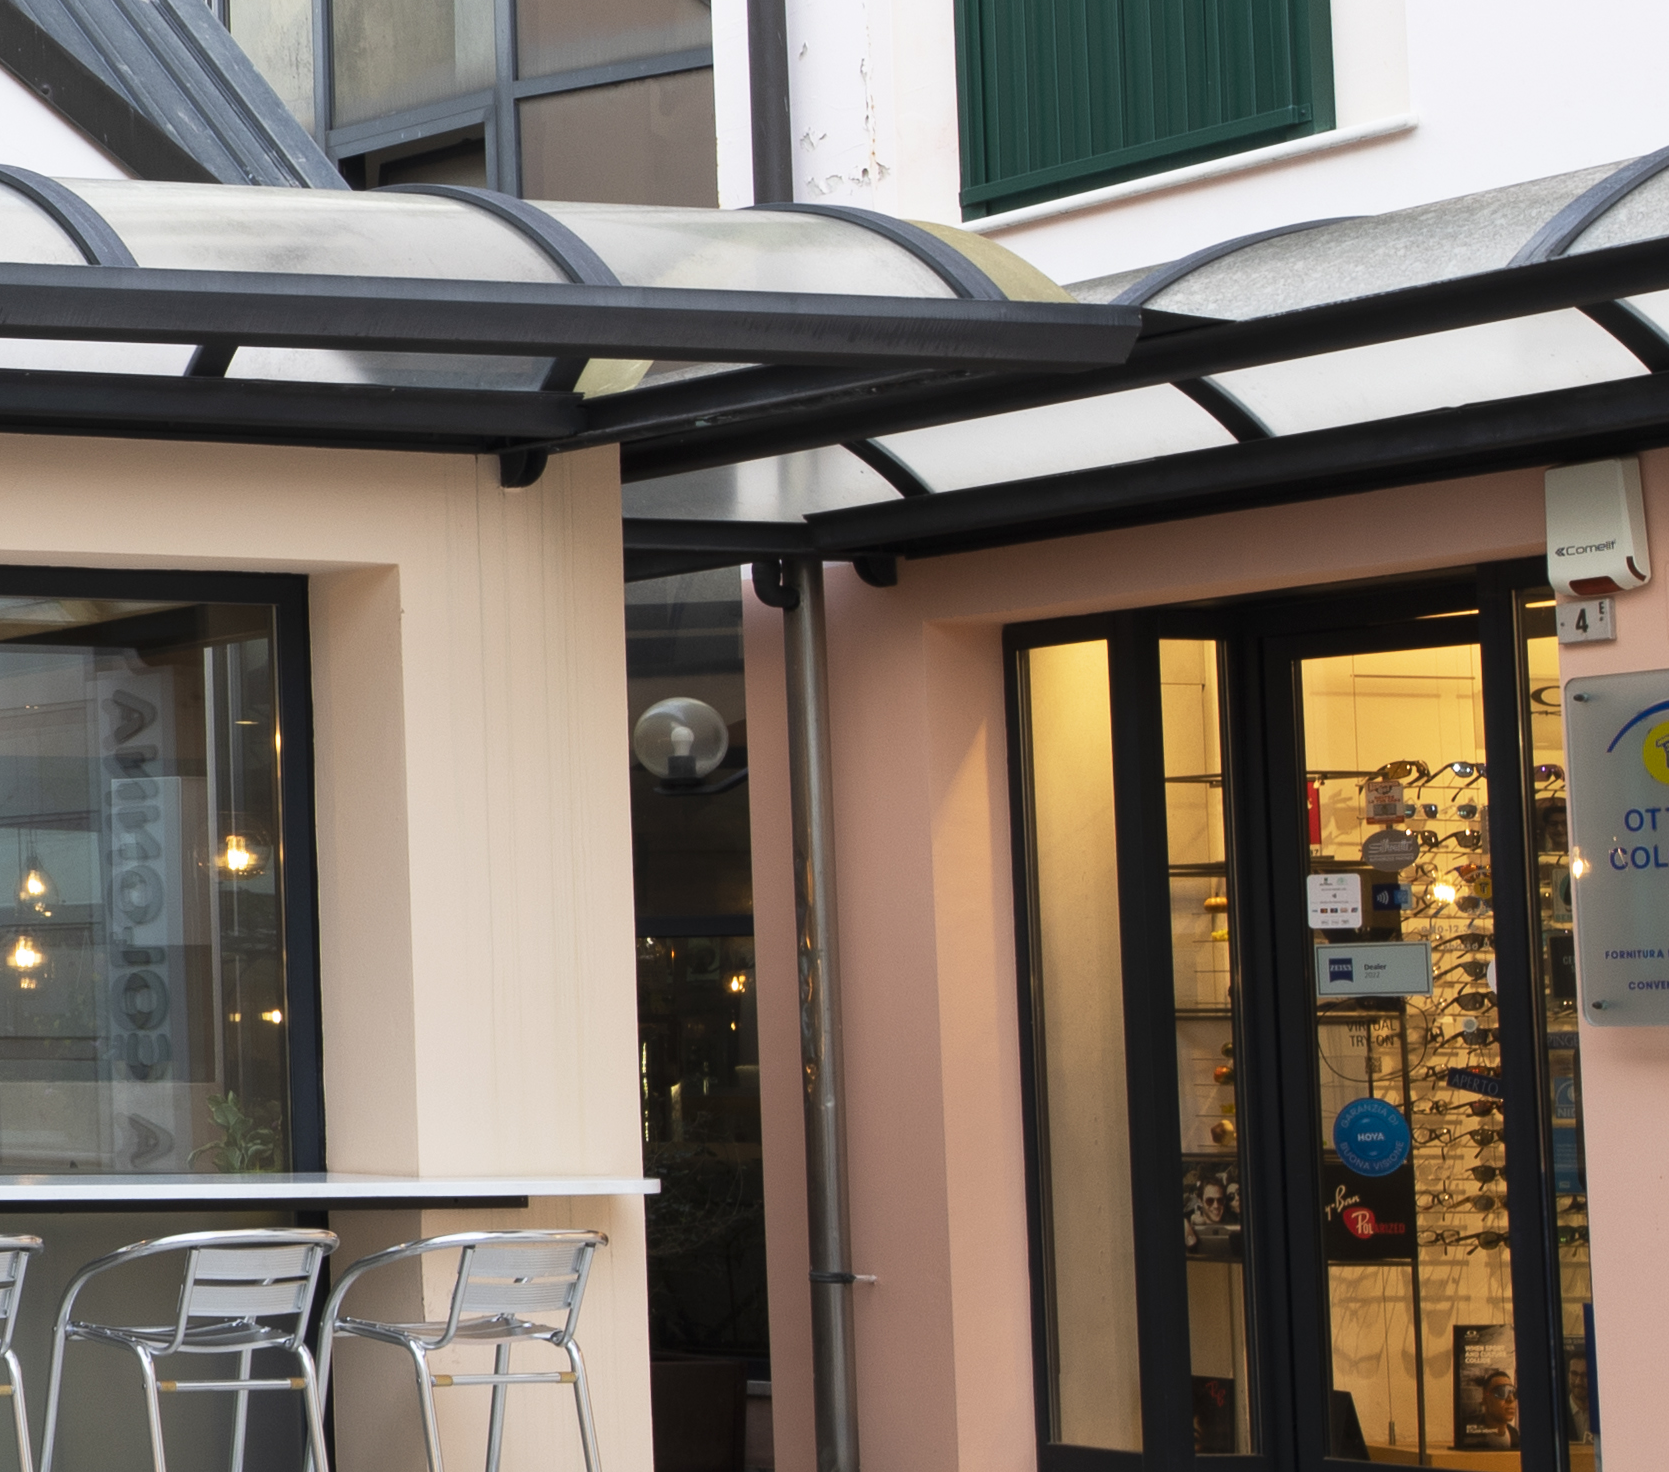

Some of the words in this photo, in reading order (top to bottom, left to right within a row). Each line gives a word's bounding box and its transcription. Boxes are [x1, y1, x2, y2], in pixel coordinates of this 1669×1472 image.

[1566, 539, 1616, 556] Comelit
[1575, 608, 1589, 633] 4
[1598, 601, 1605, 615] E
[1605, 948, 1664, 960] FORNITURA
[1330, 964, 1352, 972] ZEISS
[1346, 1019, 1397, 1032] VIRTUAL
[1350, 1034, 1394, 1048] TRY-ON
[1451, 1074, 1499, 1096] APERTO
[1340, 1104, 1387, 1129] GARANZIA
[1388, 1112, 1399, 1127] DI
[1357, 1132, 1385, 1142] HOYA
[1340, 1141, 1370, 1170] BUONA
[1373, 1140, 1404, 1171] VISIONE
